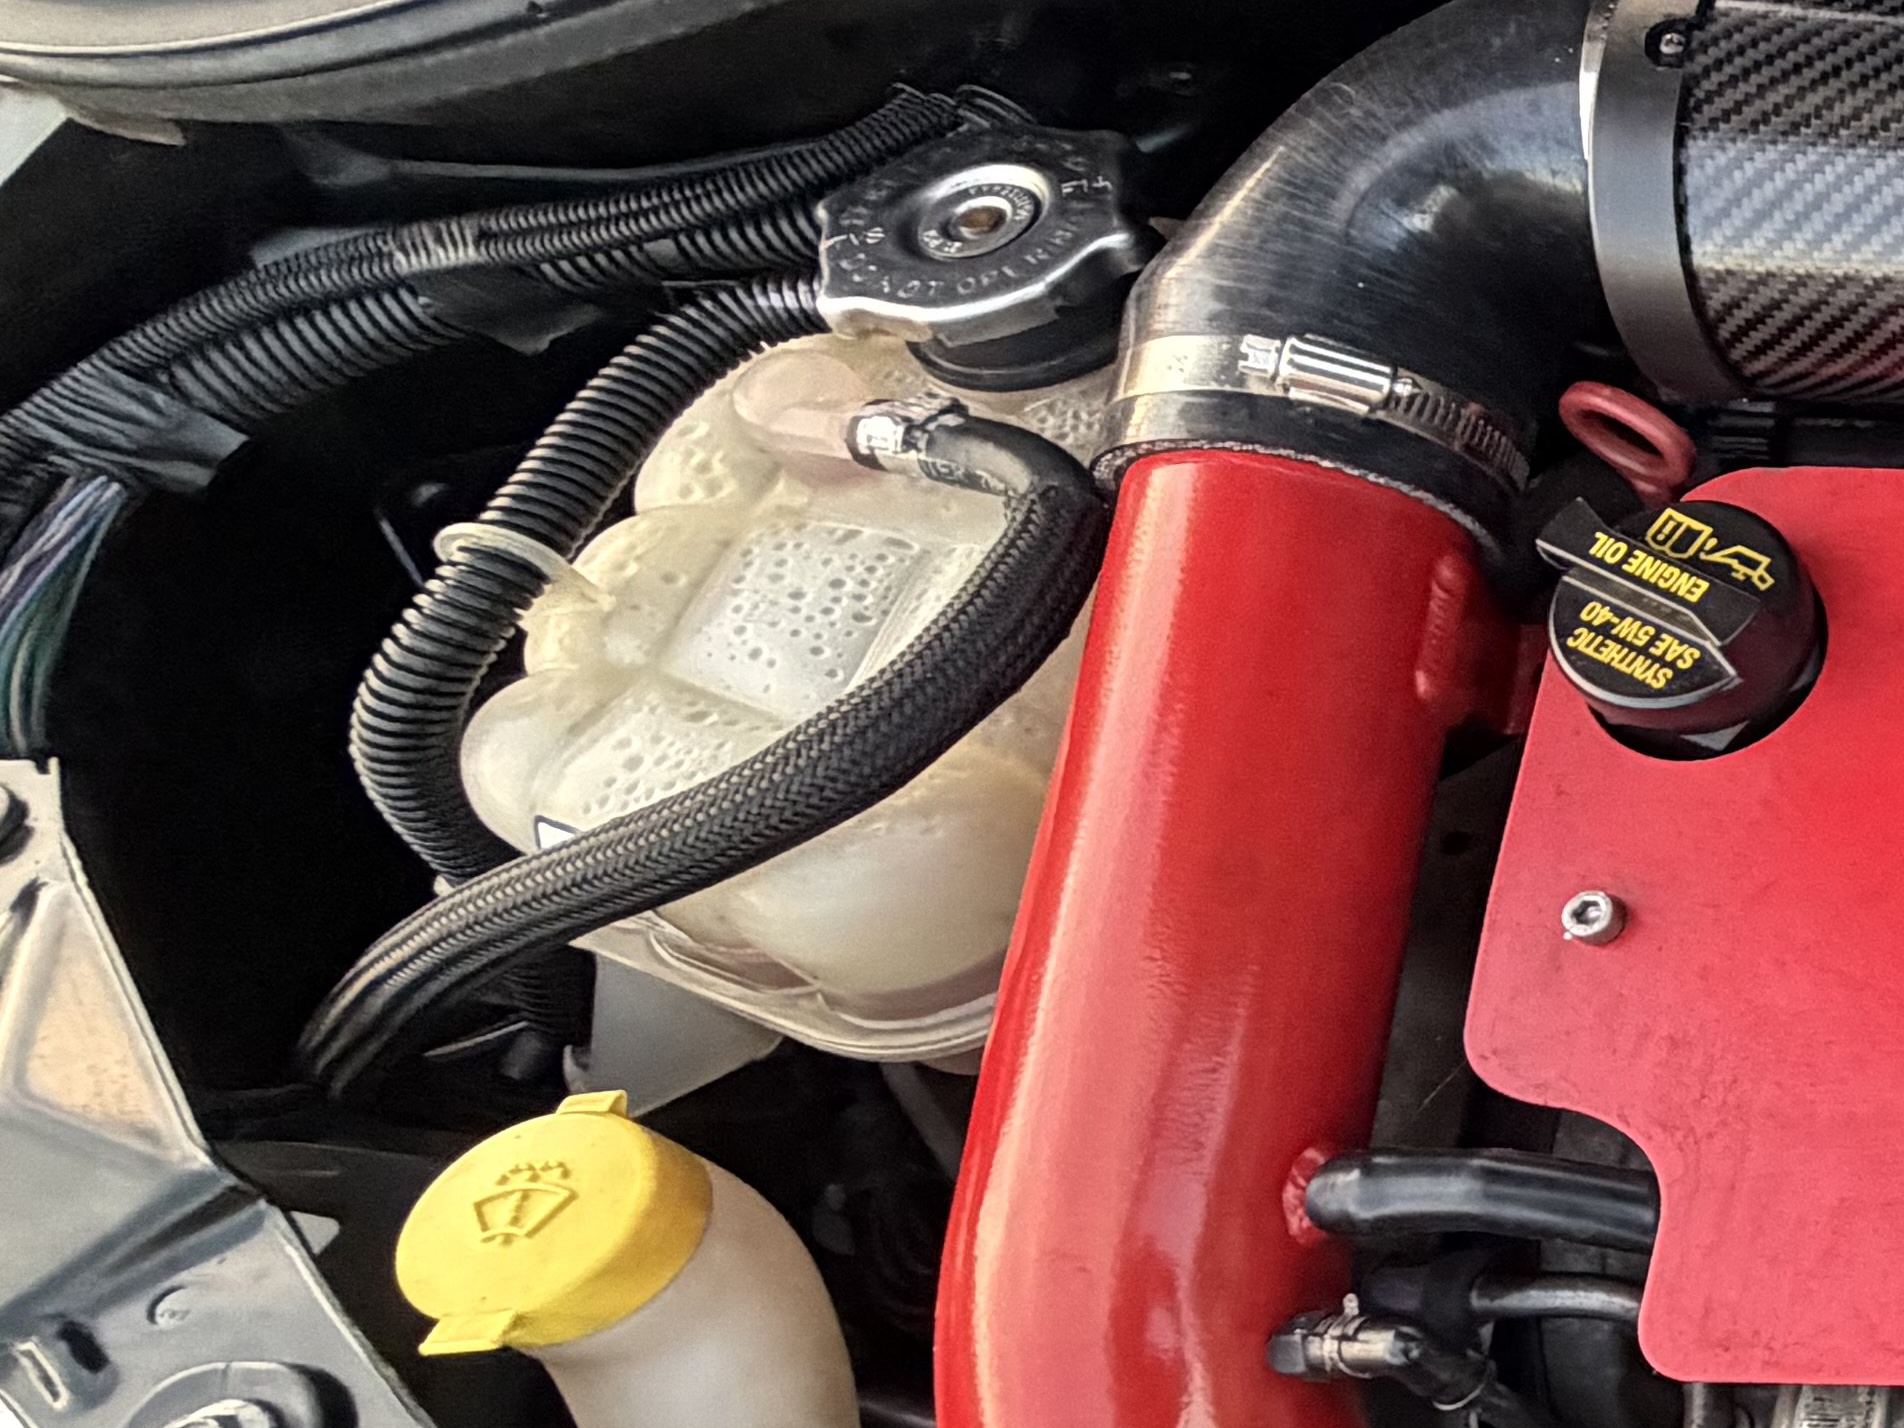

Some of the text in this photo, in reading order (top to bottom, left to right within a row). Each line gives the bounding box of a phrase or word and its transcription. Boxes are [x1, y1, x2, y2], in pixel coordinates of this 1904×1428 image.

[1589, 532, 1710, 604] ENGINE OIL
[1566, 627, 1674, 689] SYNTHETIC
[1580, 601, 1702, 669] SAE 5W-40
